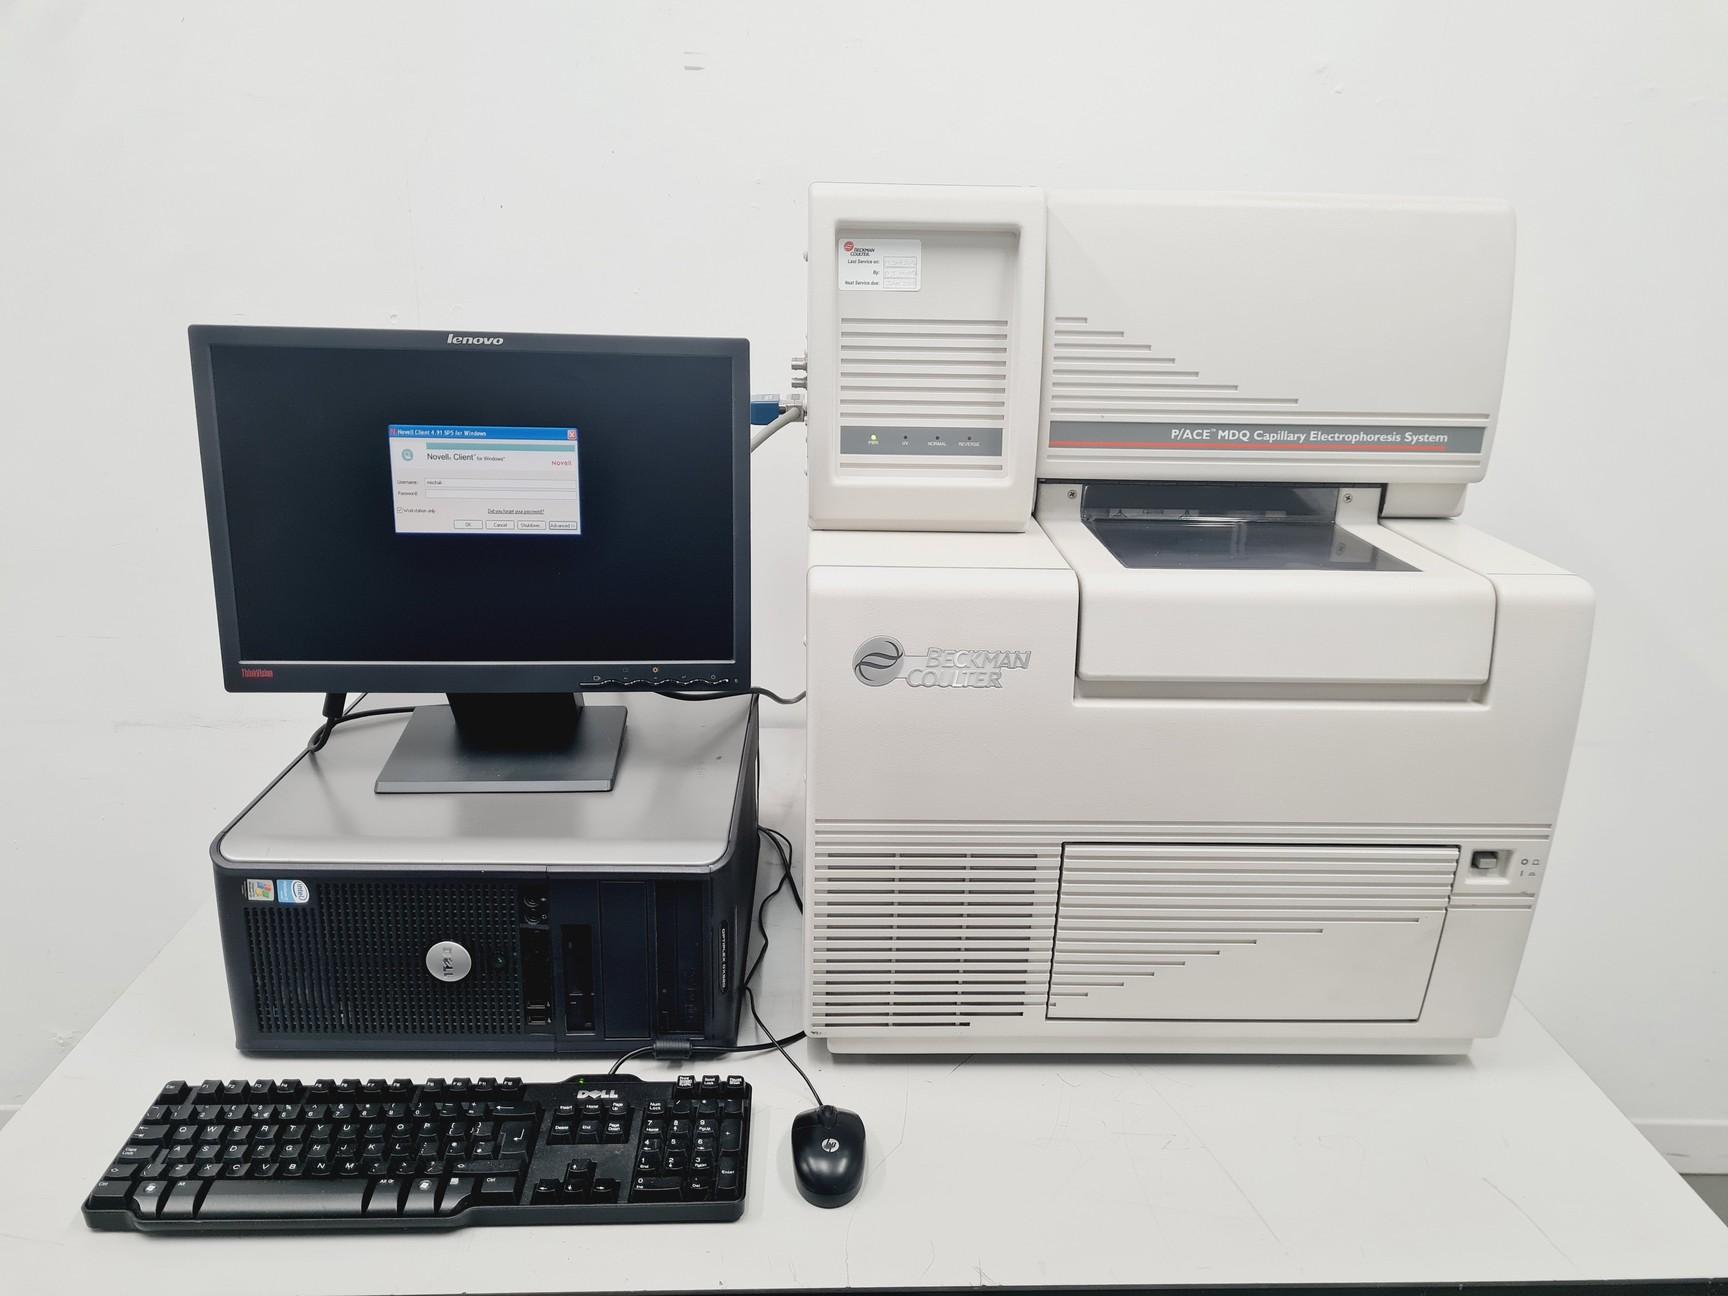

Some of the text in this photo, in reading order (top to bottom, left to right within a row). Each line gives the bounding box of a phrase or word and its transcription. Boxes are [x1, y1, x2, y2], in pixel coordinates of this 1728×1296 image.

[447, 333, 504, 345] lenovo
[1218, 430, 1250, 441] MDQ
[1254, 430, 1306, 443] Capillary
[1309, 430, 1401, 444] Electrophoresis
[1404, 431, 1448, 445] System
[926, 647, 1031, 669] BECKMAN
[906, 669, 1002, 688] COULTER
[576, 1089, 619, 1099] DELL
